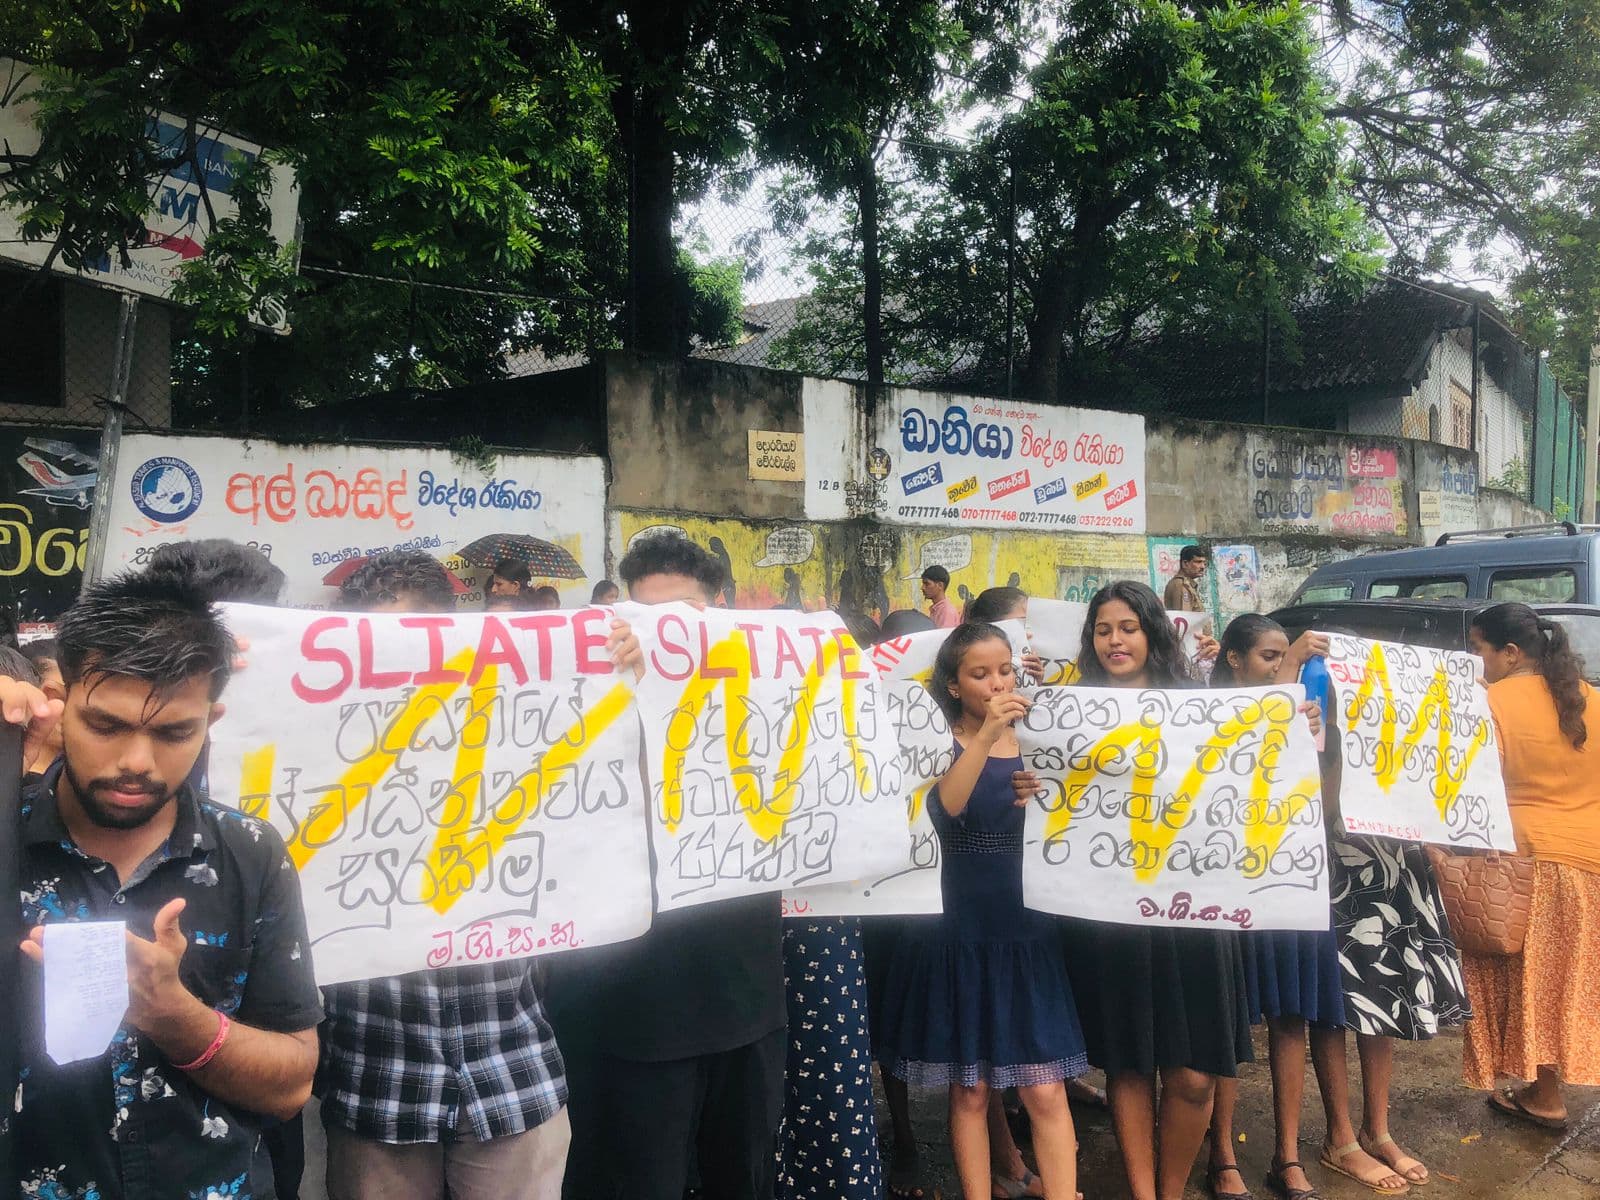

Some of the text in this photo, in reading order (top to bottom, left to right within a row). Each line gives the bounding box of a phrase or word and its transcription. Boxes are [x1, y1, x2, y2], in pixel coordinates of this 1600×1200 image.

[114, 252, 158, 277] LNKA
[900, 406, 1124, 468] ඩානියා විදේශ රැකියා
[225, 462, 297, 526] අල්
[418, 470, 477, 518] විදේශ
[479, 477, 542, 511] රැකියා
[818, 480, 829, 490] 12
[290, 608, 616, 704] SLIATE
